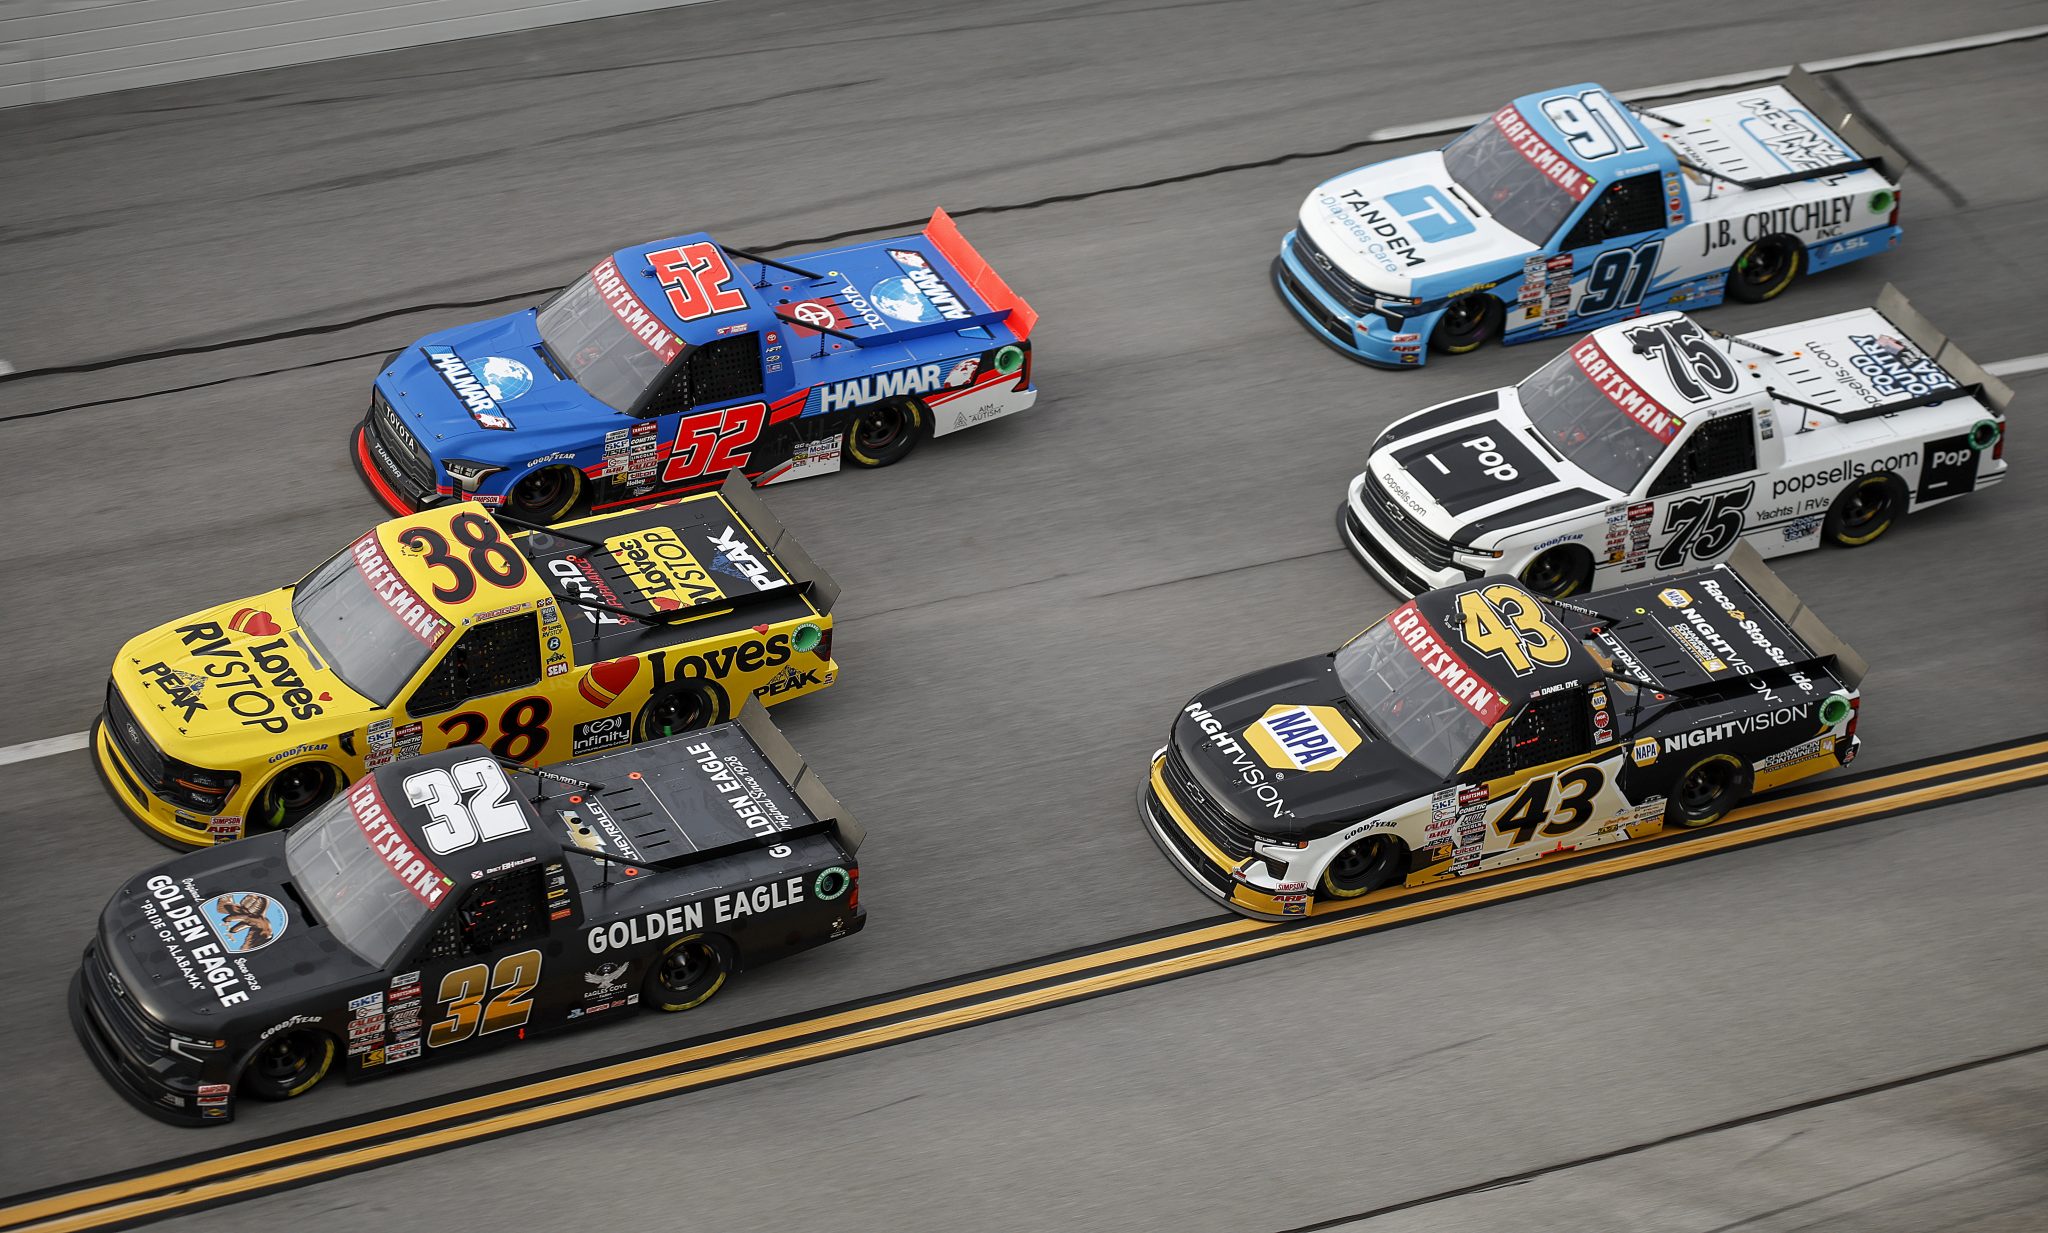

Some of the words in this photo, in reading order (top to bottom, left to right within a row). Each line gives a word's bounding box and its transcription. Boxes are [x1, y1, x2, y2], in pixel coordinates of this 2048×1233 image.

[1495, 107, 1582, 188] CRAFTSMAN
[1538, 88, 1648, 162] 91
[1321, 196, 1371, 243] Diabetes
[1367, 243, 1398, 272] Care
[1341, 189, 1426, 267] TANDEM
[1703, 219, 1737, 256] J.B.
[1743, 194, 1855, 242] CRITCHLEY
[1817, 225, 1843, 240] INC.
[1830, 236, 1869, 254] ASL
[646, 241, 748, 321] 52
[908, 268, 972, 320] ALMAR
[1577, 238, 1665, 316] 91
[594, 258, 672, 352] CRAFTSMAN
[841, 284, 886, 330] TOYOTA
[430, 350, 495, 412] HALMAR
[1622, 313, 1739, 404] 75
[1848, 335, 1929, 397] OUNTRY
[1849, 354, 1906, 397] FOOD
[820, 364, 942, 414] HALMAR
[1574, 342, 1671, 434] CRAFTSMAN
[385, 406, 415, 450] TOYOTA
[605, 440, 626, 450] SKF
[661, 401, 768, 484] 52
[809, 442, 830, 453] Mobil
[374, 442, 402, 478] TUNDRA
[527, 451, 575, 468] GOODYEAR
[1462, 436, 1519, 481] Pop
[1773, 450, 1919, 499] popsells.com
[1932, 449, 1971, 468] Pop
[1382, 473, 1428, 517] popsells.com
[1756, 504, 1793, 521] Yachts
[1804, 496, 1830, 512] RVs
[1533, 532, 1583, 551] GOODYEAR
[1656, 480, 1756, 571] 75
[397, 511, 528, 605] 38
[619, 538, 671, 594] Loves
[707, 525, 788, 592] PEAK
[354, 537, 439, 639] CRAFTSMAN
[1555, 600, 1598, 617] CHEVROLET
[1454, 583, 1571, 678] 43
[1681, 608, 1779, 701] NIGHTVISON
[1699, 580, 1736, 611] Race
[1738, 620, 1772, 648] Stop
[1765, 647, 1813, 691] Suiide
[247, 637, 324, 720] Loves
[547, 662, 568, 676] SEM
[647, 633, 792, 696] Loves
[1393, 606, 1493, 712] CRAFTSMAN
[138, 661, 209, 723] PEAK
[753, 668, 822, 701] PEAK
[1541, 684, 1565, 695] DANIEL
[1565, 679, 1579, 689] DYE
[367, 731, 392, 743] SKF
[394, 736, 422, 747] COMETIC
[573, 729, 630, 750] Infinity
[1267, 711, 1337, 765] NAPA
[1636, 744, 1656, 760] NAPA
[1664, 703, 1808, 753] NIGHTVISION
[1765, 740, 1820, 762] CHAMPION
[267, 743, 329, 764] GOODYEAR
[723, 755, 749, 776] 1928
[744, 775, 767, 800] Since
[1185, 702, 1285, 818] NIGHTVISION
[1765, 745, 1820, 767] CONTAINER
[538, 771, 590, 789] CHEVROLET
[686, 742, 742, 793] EAGLE
[727, 794, 792, 859] GLDEN
[1460, 790, 1488, 801] CRAFTSMAN
[1491, 763, 1605, 846] 43
[402, 756, 531, 857] 32
[1344, 818, 1397, 841] GOODYEAR
[1432, 799, 1454, 811] SKF
[350, 784, 439, 897] CRAFTSMAN
[181, 877, 206, 903] Original
[1277, 882, 1306, 890] SIMPSON
[159, 930, 175, 942] OF
[587, 901, 703, 954] GOLDEN
[714, 876, 805, 923] EAGLE
[146, 875, 210, 943] GOLDEN
[191, 942, 250, 1008] EAGLE
[234, 957, 249, 977] Since
[244, 972, 262, 991] 1928
[427, 949, 543, 1048] 32
[583, 988, 608, 999] EAGLES
[609, 982, 629, 992] COVE
[350, 993, 382, 1009] SKF
[260, 1014, 323, 1040] GOODYEAR
